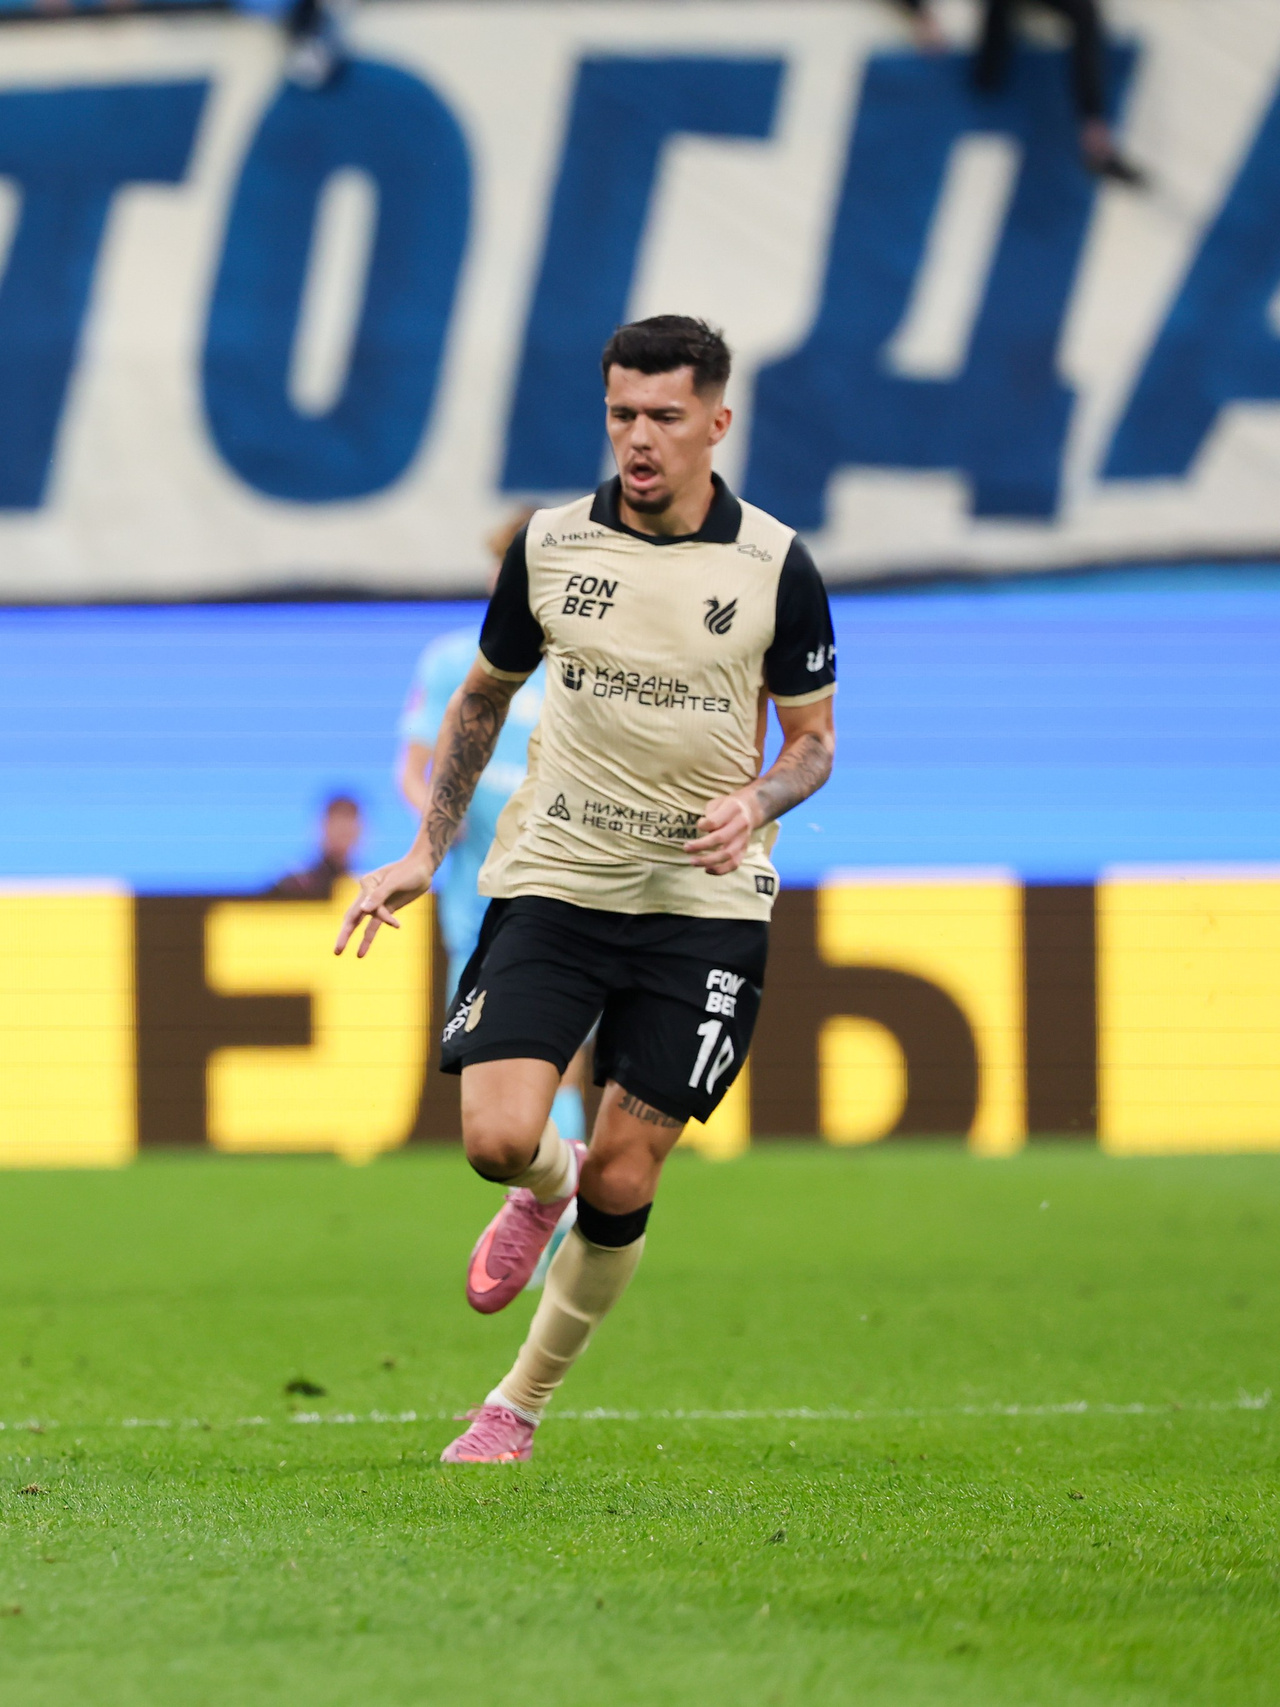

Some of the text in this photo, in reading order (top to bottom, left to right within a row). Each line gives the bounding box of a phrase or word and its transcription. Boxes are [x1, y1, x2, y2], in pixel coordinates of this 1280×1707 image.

[565, 574, 618, 598] FON
[562, 595, 614, 619] BET
[595, 666, 689, 694] КАЗАНЬ
[593, 682, 731, 713] ОРГСИНТЕЗ
[584, 799, 706, 826] НИЖНЕКАМ
[582, 814, 697, 839] НЕФТЕХИМ
